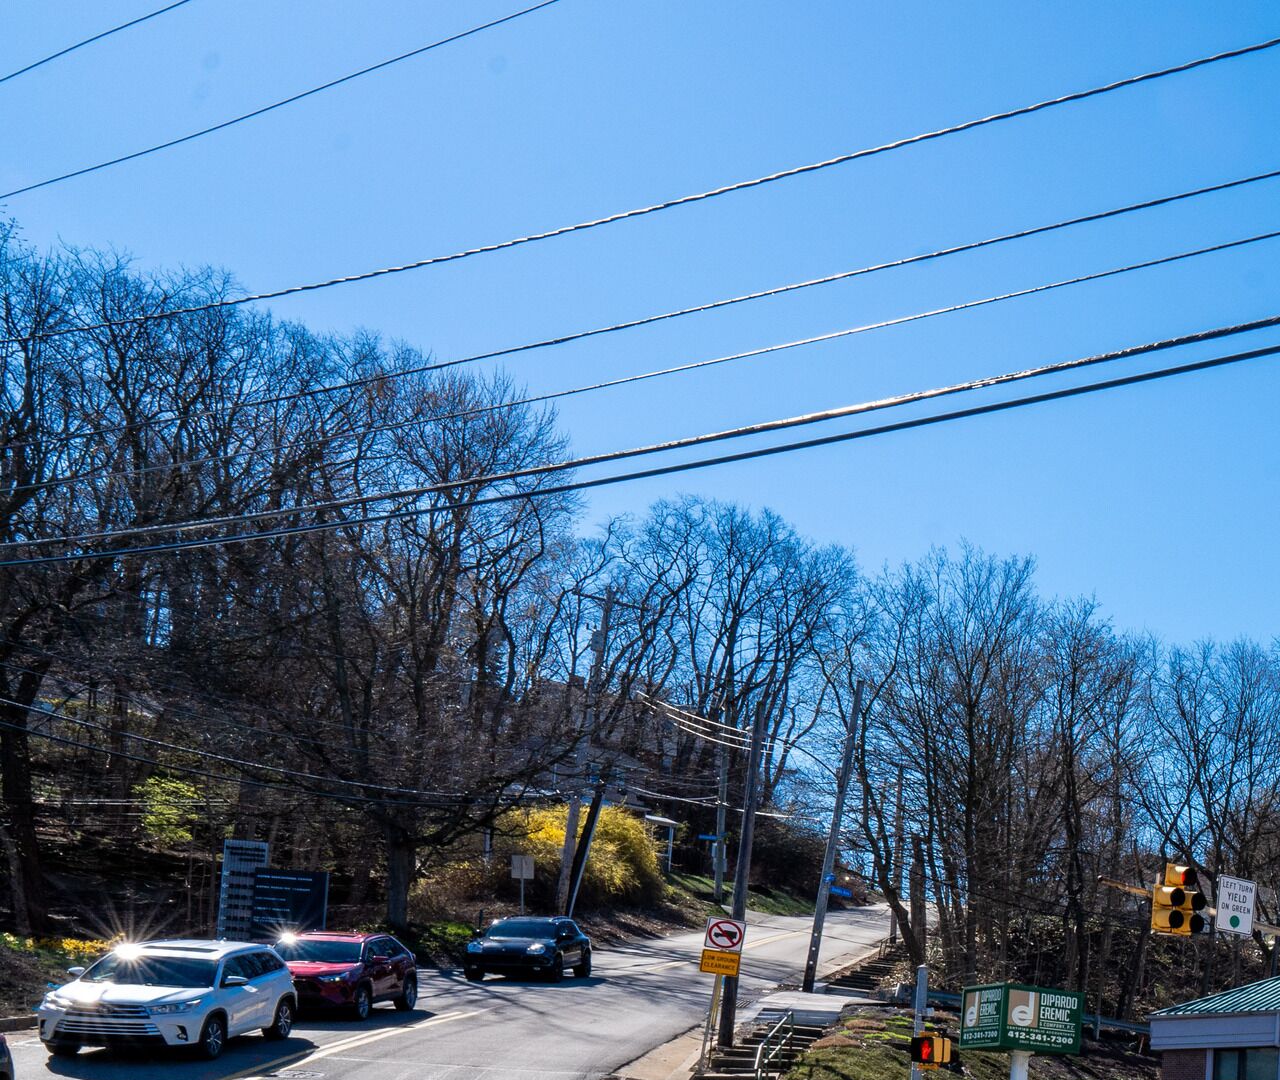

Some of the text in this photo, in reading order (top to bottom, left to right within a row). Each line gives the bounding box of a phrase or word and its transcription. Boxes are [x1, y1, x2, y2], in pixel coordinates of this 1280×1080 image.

[1222, 879, 1254, 894] LEFT TURN
[1227, 892, 1247, 904] YIELD
[1221, 902, 1251, 914] ON GREEN
[703, 961, 736, 970] CLEARANCE
[1041, 993, 1078, 1010] DIPARDO
[1040, 1006, 1071, 1022] EREMIC
[1008, 1030, 1074, 1045] 412-341-7300
